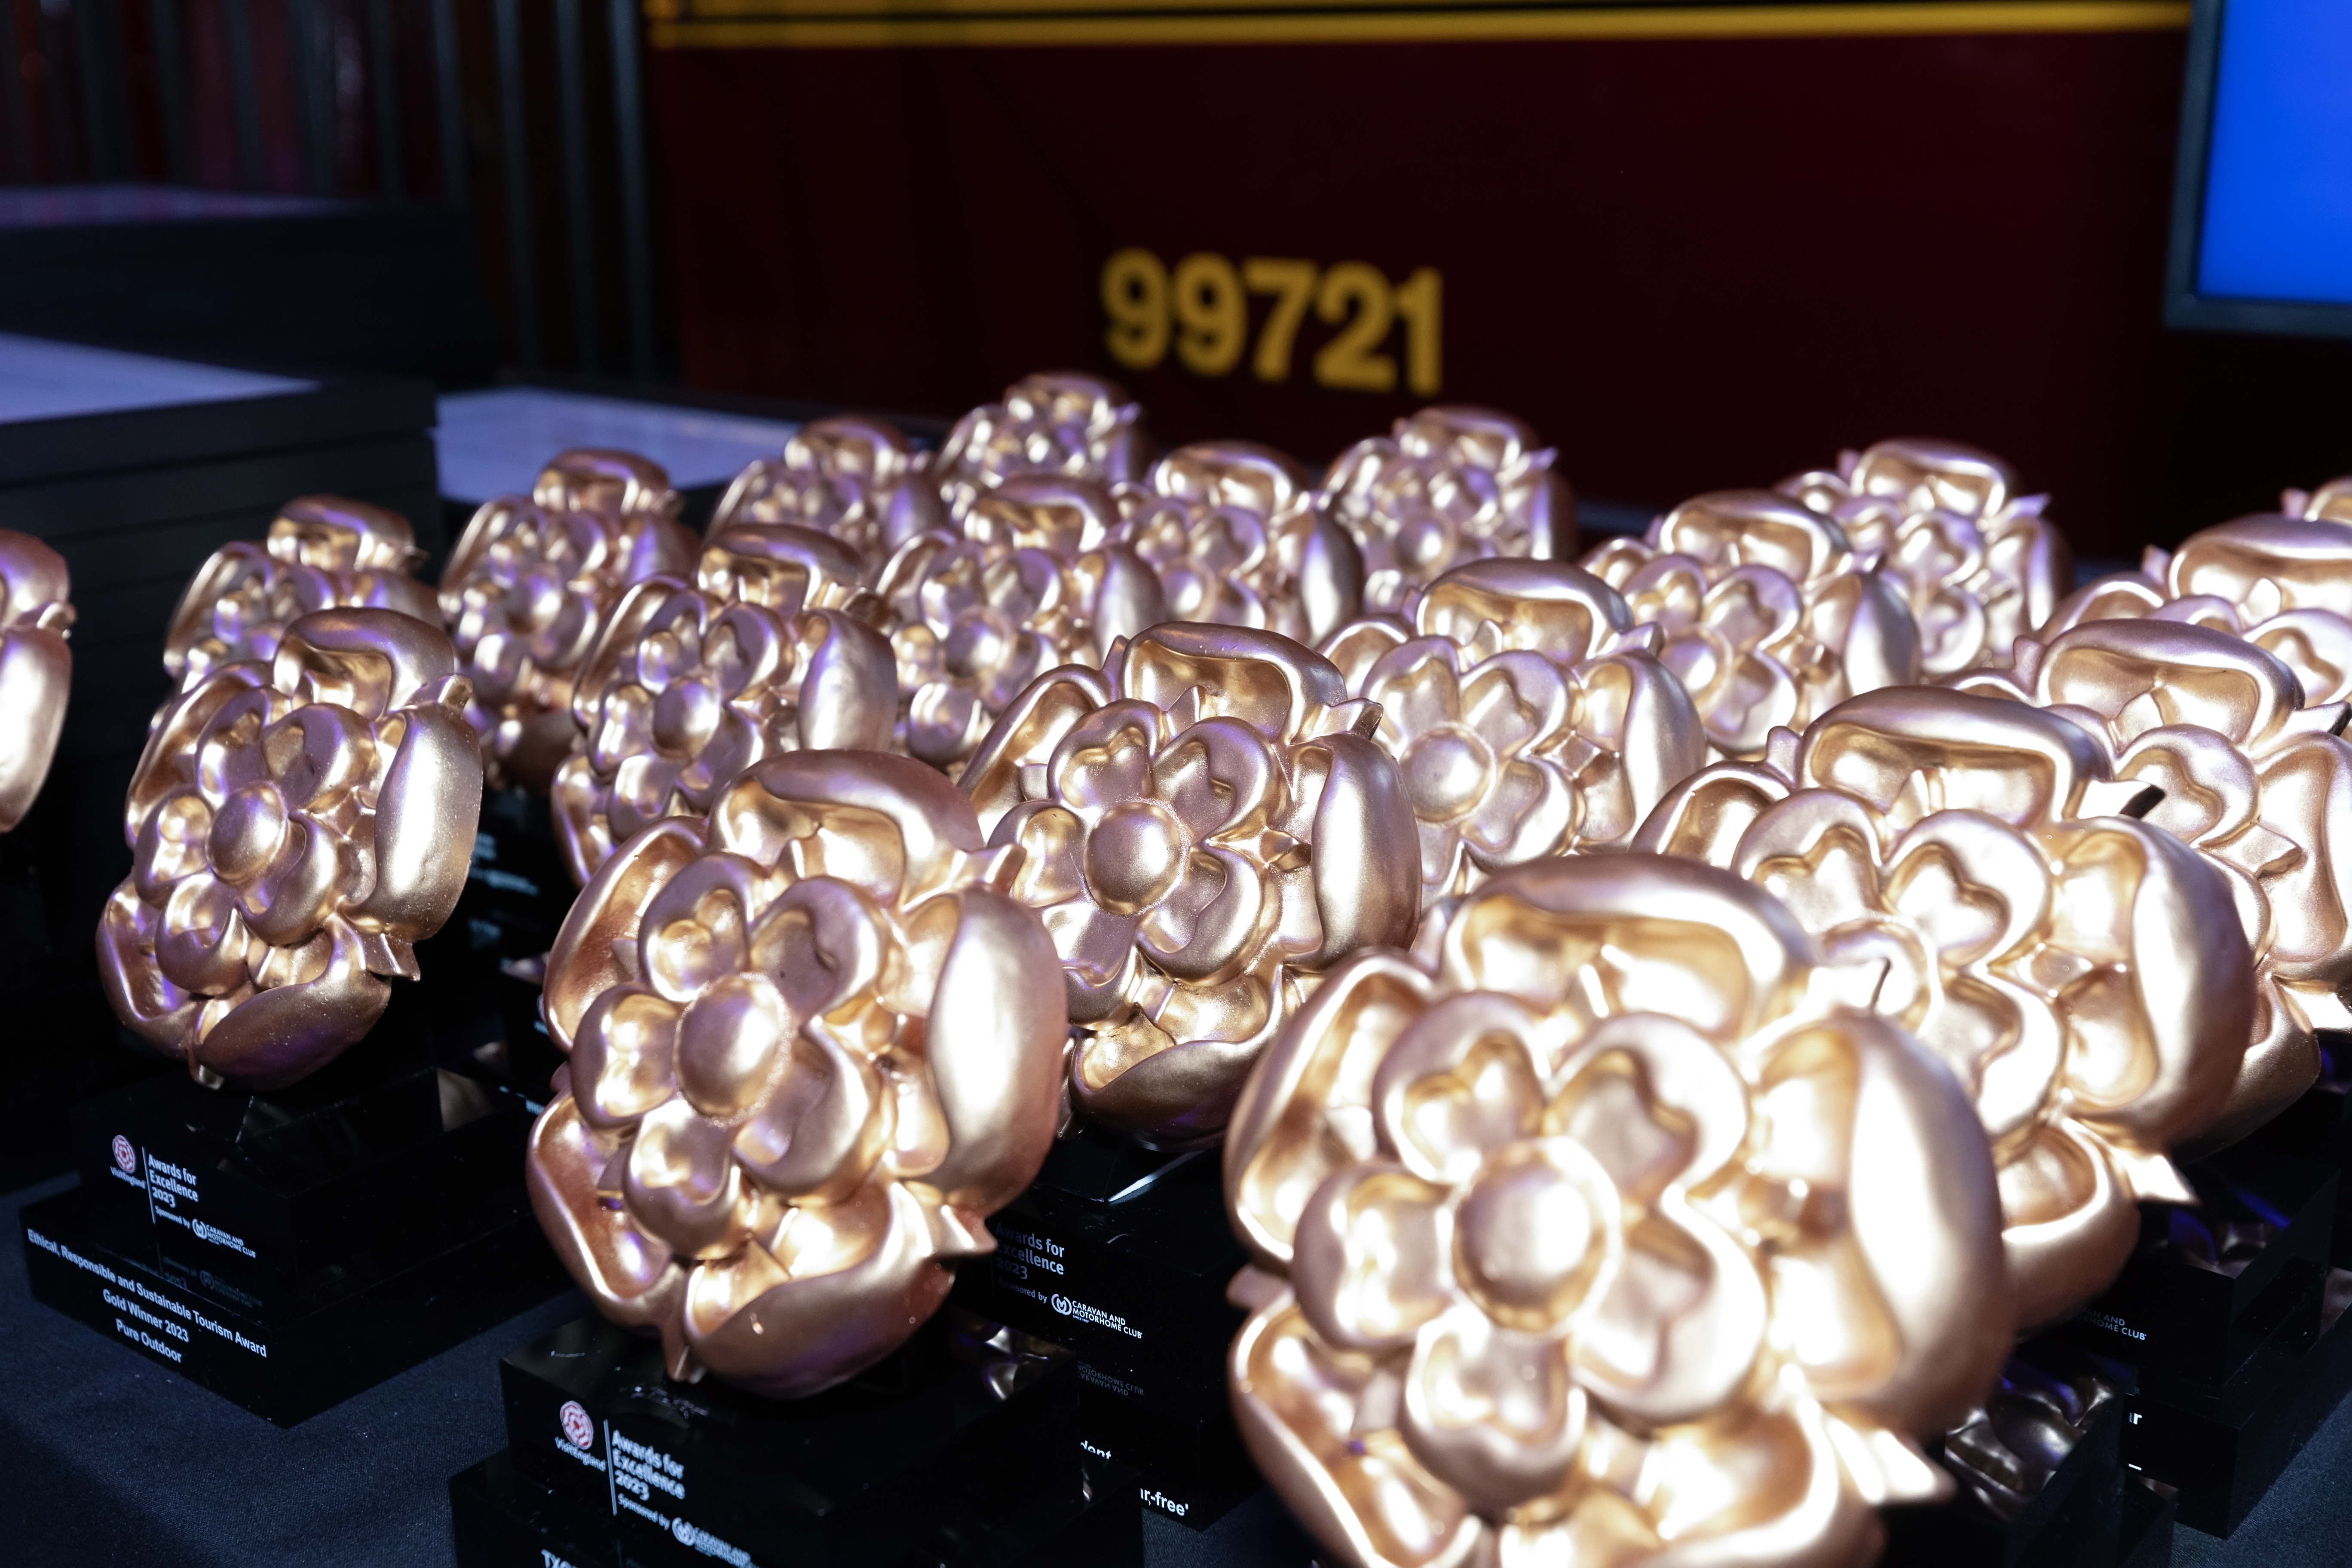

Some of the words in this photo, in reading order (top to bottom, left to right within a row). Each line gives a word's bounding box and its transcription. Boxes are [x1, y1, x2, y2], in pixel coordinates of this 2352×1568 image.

[1099, 248, 1443, 395] 99721
[148, 1154, 182, 1180] Awards
[183, 1167, 196, 1186] for
[149, 1169, 199, 1203] Excellence
[152, 1187, 176, 1208] 2023
[206, 1224, 231, 1240] CARAVAN
[232, 1236, 244, 1246] AND
[995, 1222, 1043, 1250] Awards
[1046, 1238, 1065, 1258] for
[996, 1257, 1028, 1280] 2023
[27, 1228, 61, 1258] Ethical,
[61, 1245, 116, 1283] Responsible
[117, 1276, 135, 1292] and
[136, 1282, 192, 1320] Sustainable
[193, 1310, 233, 1341] Tourism
[234, 1332, 267, 1358] Award
[1038, 1291, 1047, 1304] by
[103, 1289, 127, 1312] Gold
[127, 1300, 163, 1329] Winner
[165, 1319, 189, 1343] 2023
[1072, 1300, 1107, 1319] CARAVAN
[1109, 1314, 1126, 1326] AND
[1072, 1307, 1122, 1332] MOTORHOME
[2103, 1314, 2125, 1326] AND
[116, 1318, 139, 1341] Pure
[141, 1332, 181, 1363] Outdoor
[554, 1436, 606, 1472] VisitEngland
[612, 1429, 662, 1469] Awards
[662, 1453, 685, 1480] for
[612, 1448, 686, 1500] Excellence
[614, 1469, 650, 1501] 2023
[658, 1513, 671, 1531] by
